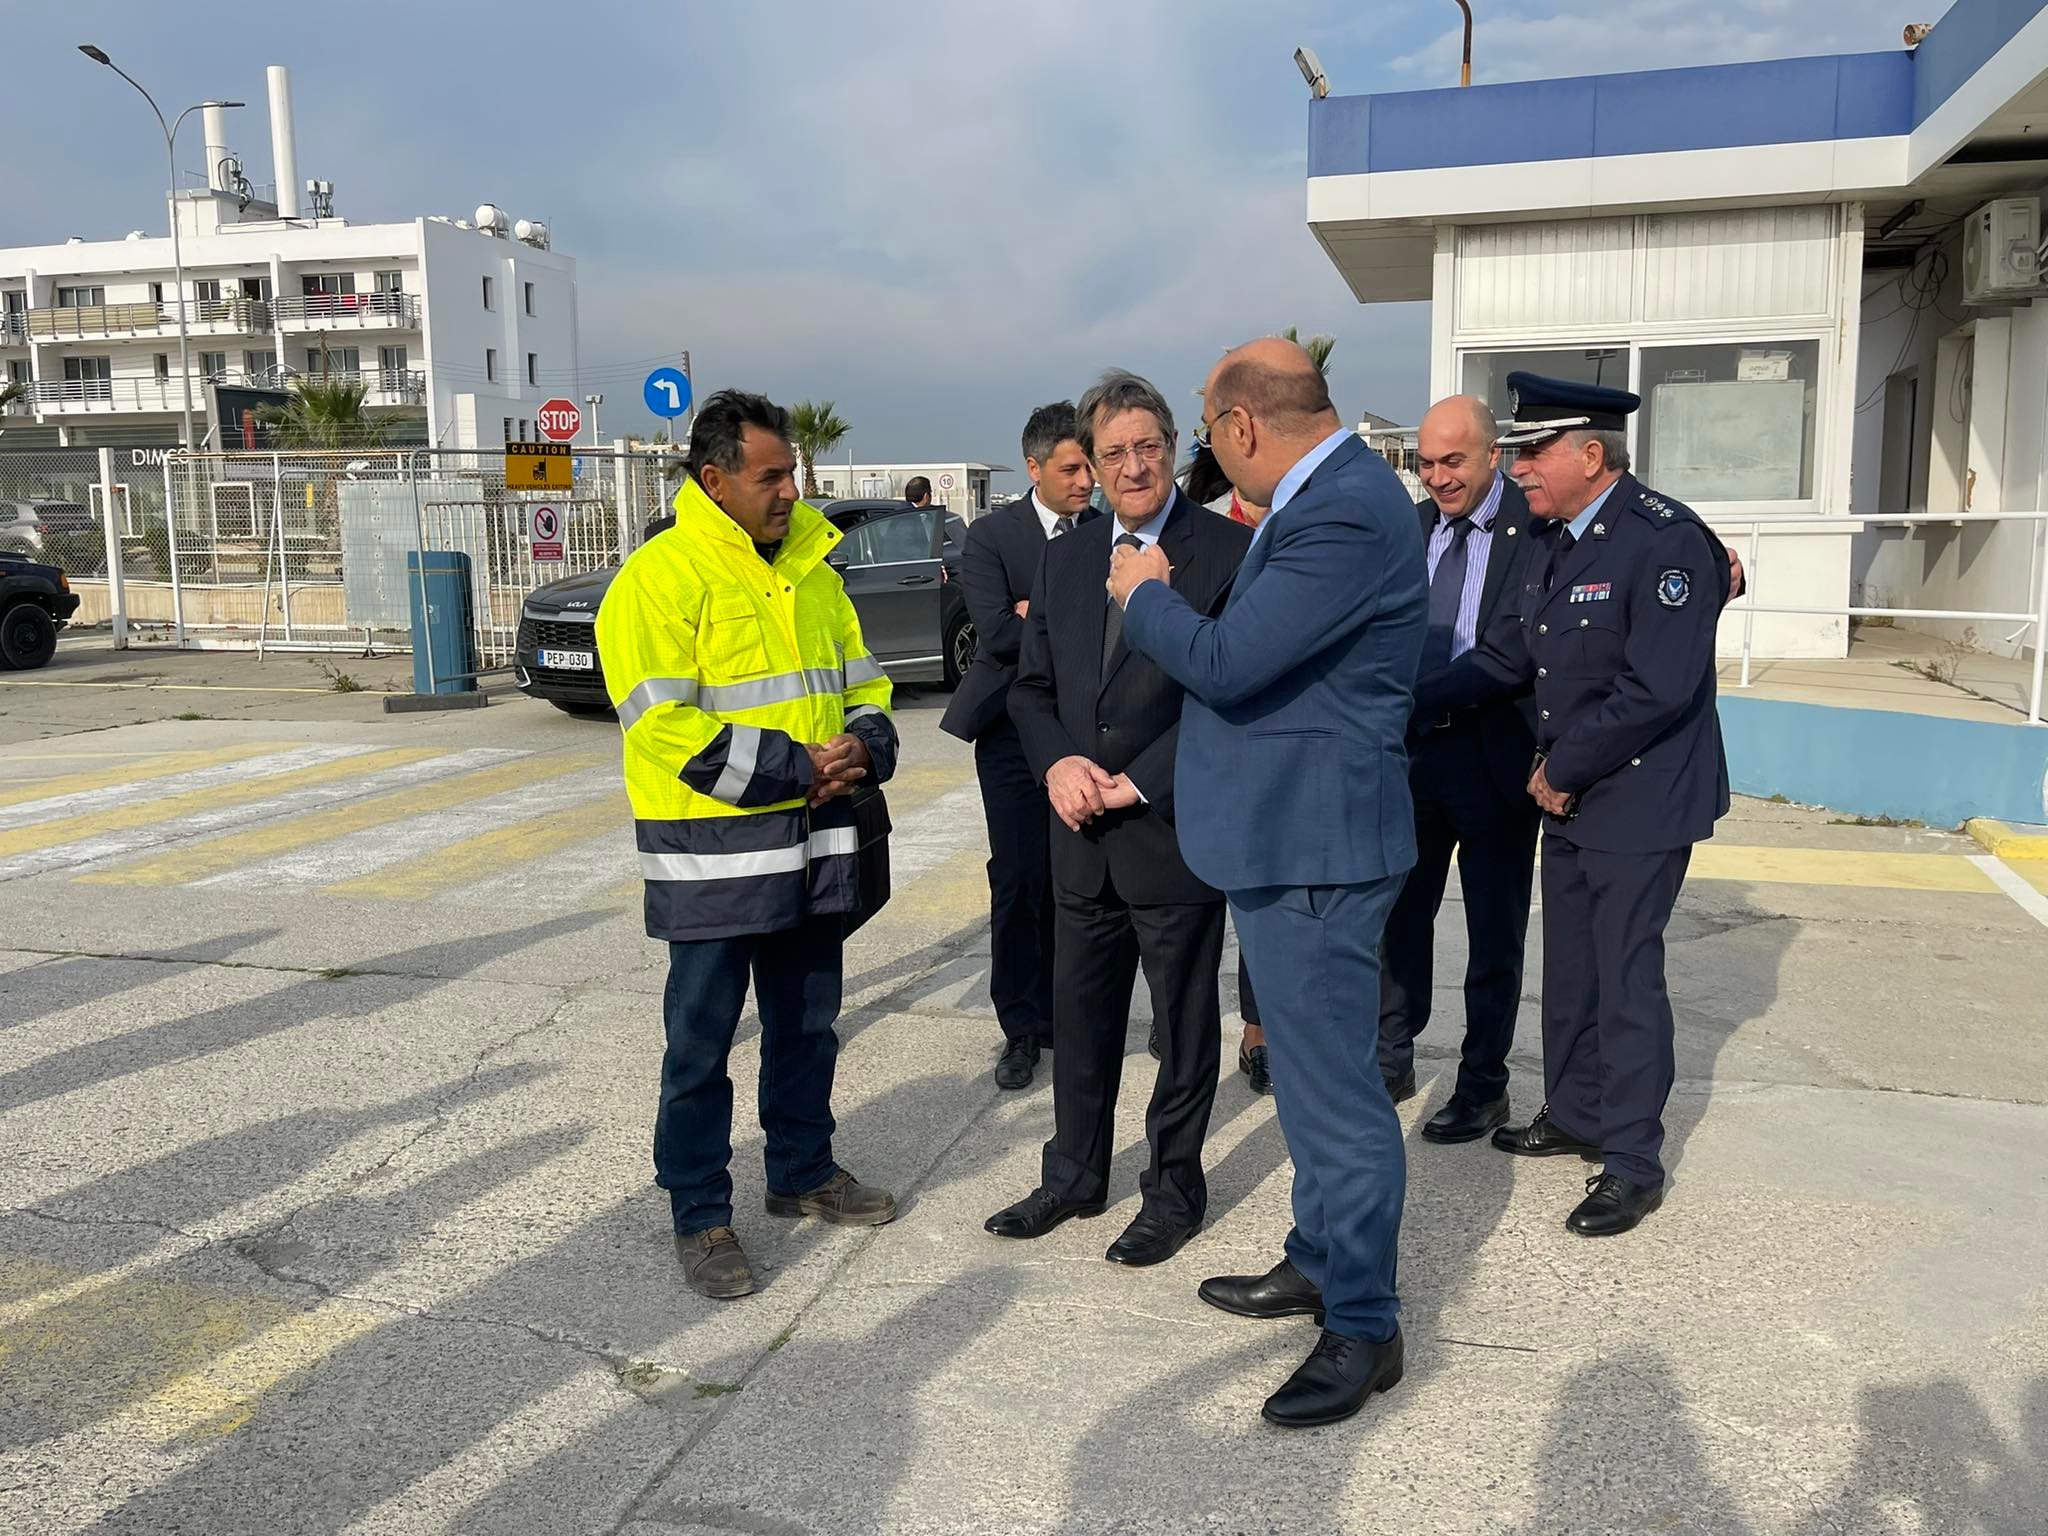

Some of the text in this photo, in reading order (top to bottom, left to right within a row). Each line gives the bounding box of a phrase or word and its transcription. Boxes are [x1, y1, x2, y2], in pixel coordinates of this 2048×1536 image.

[540, 410, 578, 431] STOP
[511, 444, 567, 455] CAUTION
[547, 652, 587, 666] PEP 030
